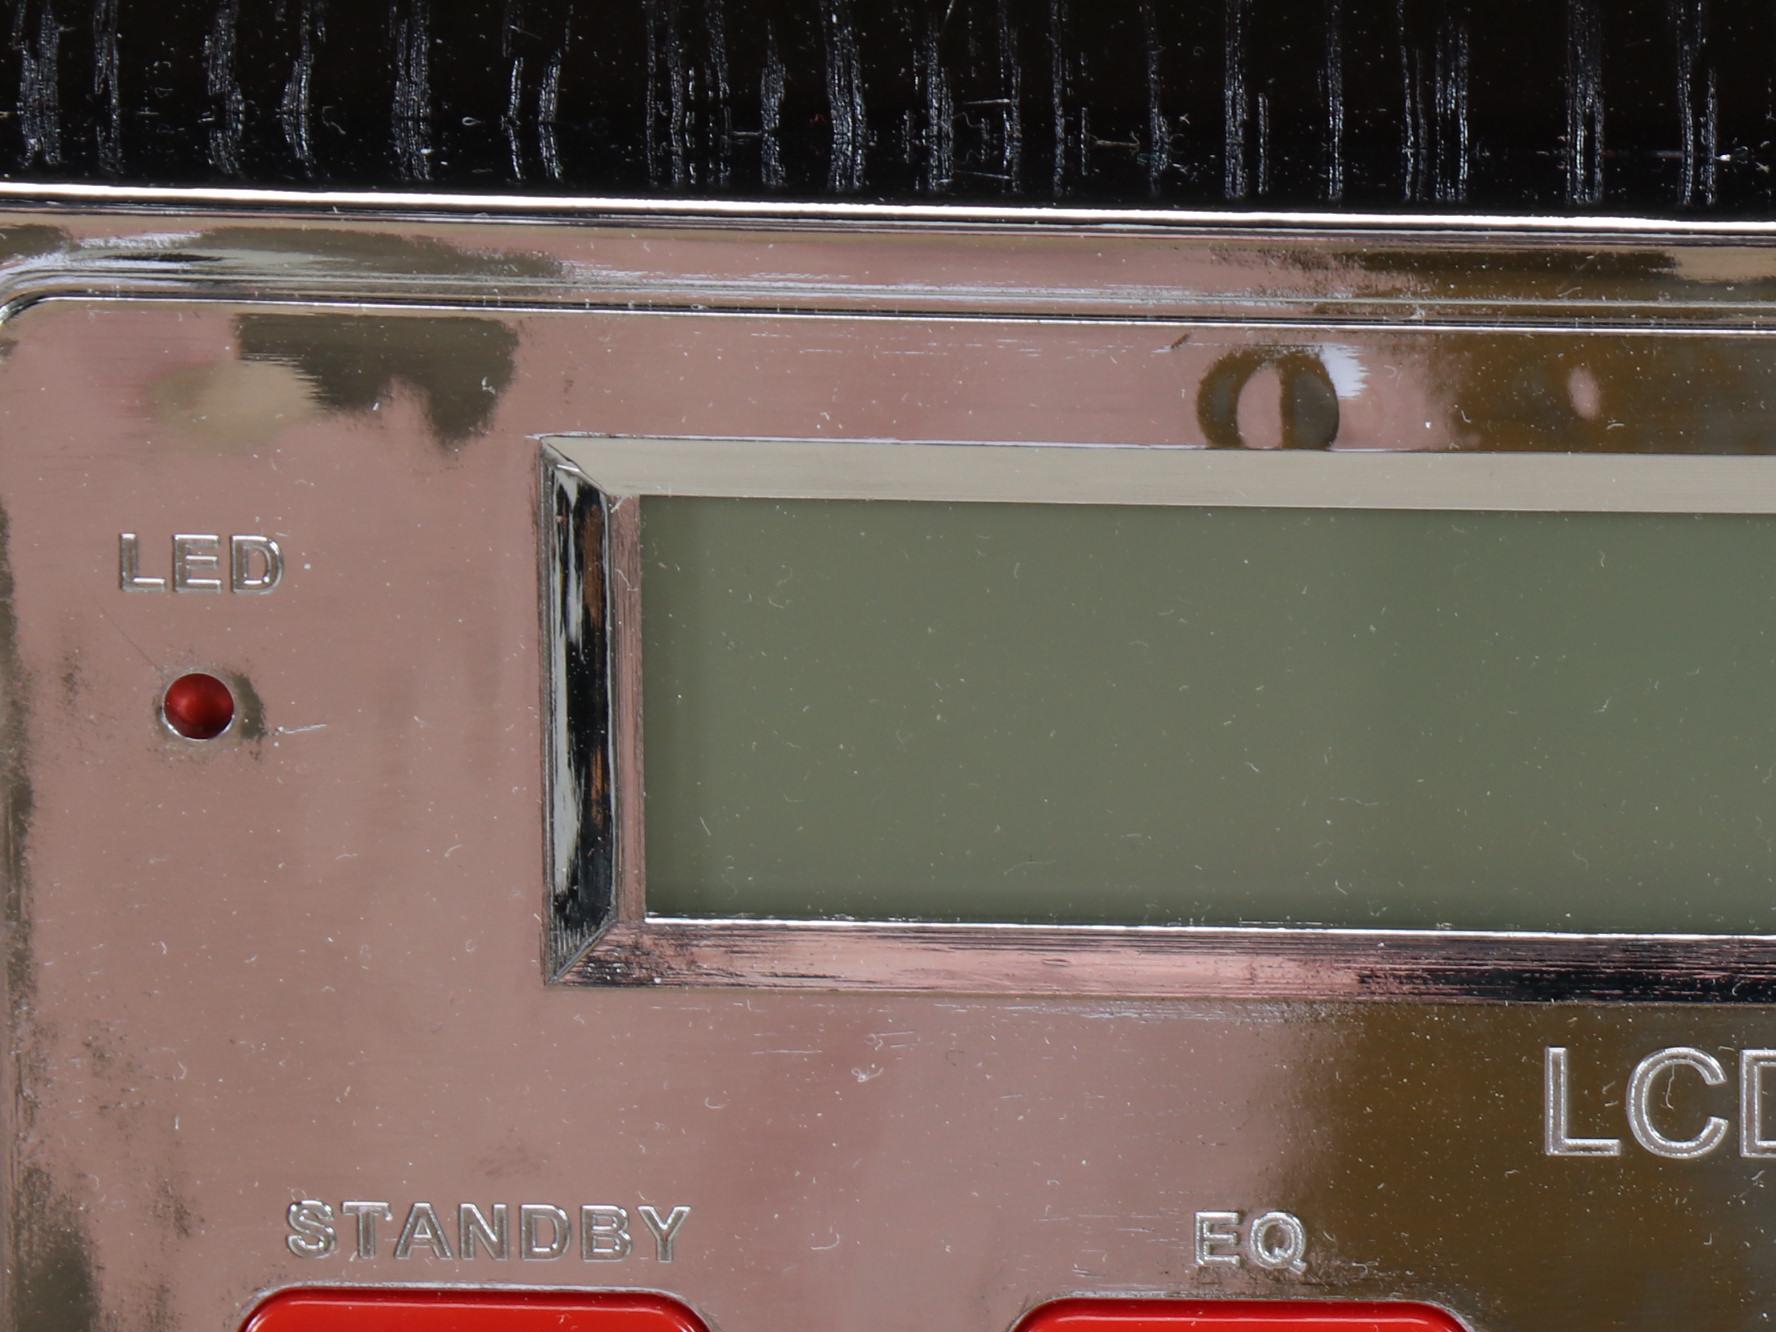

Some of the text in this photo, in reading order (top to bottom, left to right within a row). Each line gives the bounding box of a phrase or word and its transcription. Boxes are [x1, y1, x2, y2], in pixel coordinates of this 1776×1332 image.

[120, 533, 285, 595] LED
[285, 1200, 692, 1263] STANDBY
[1193, 1210, 1308, 1275] EQ
